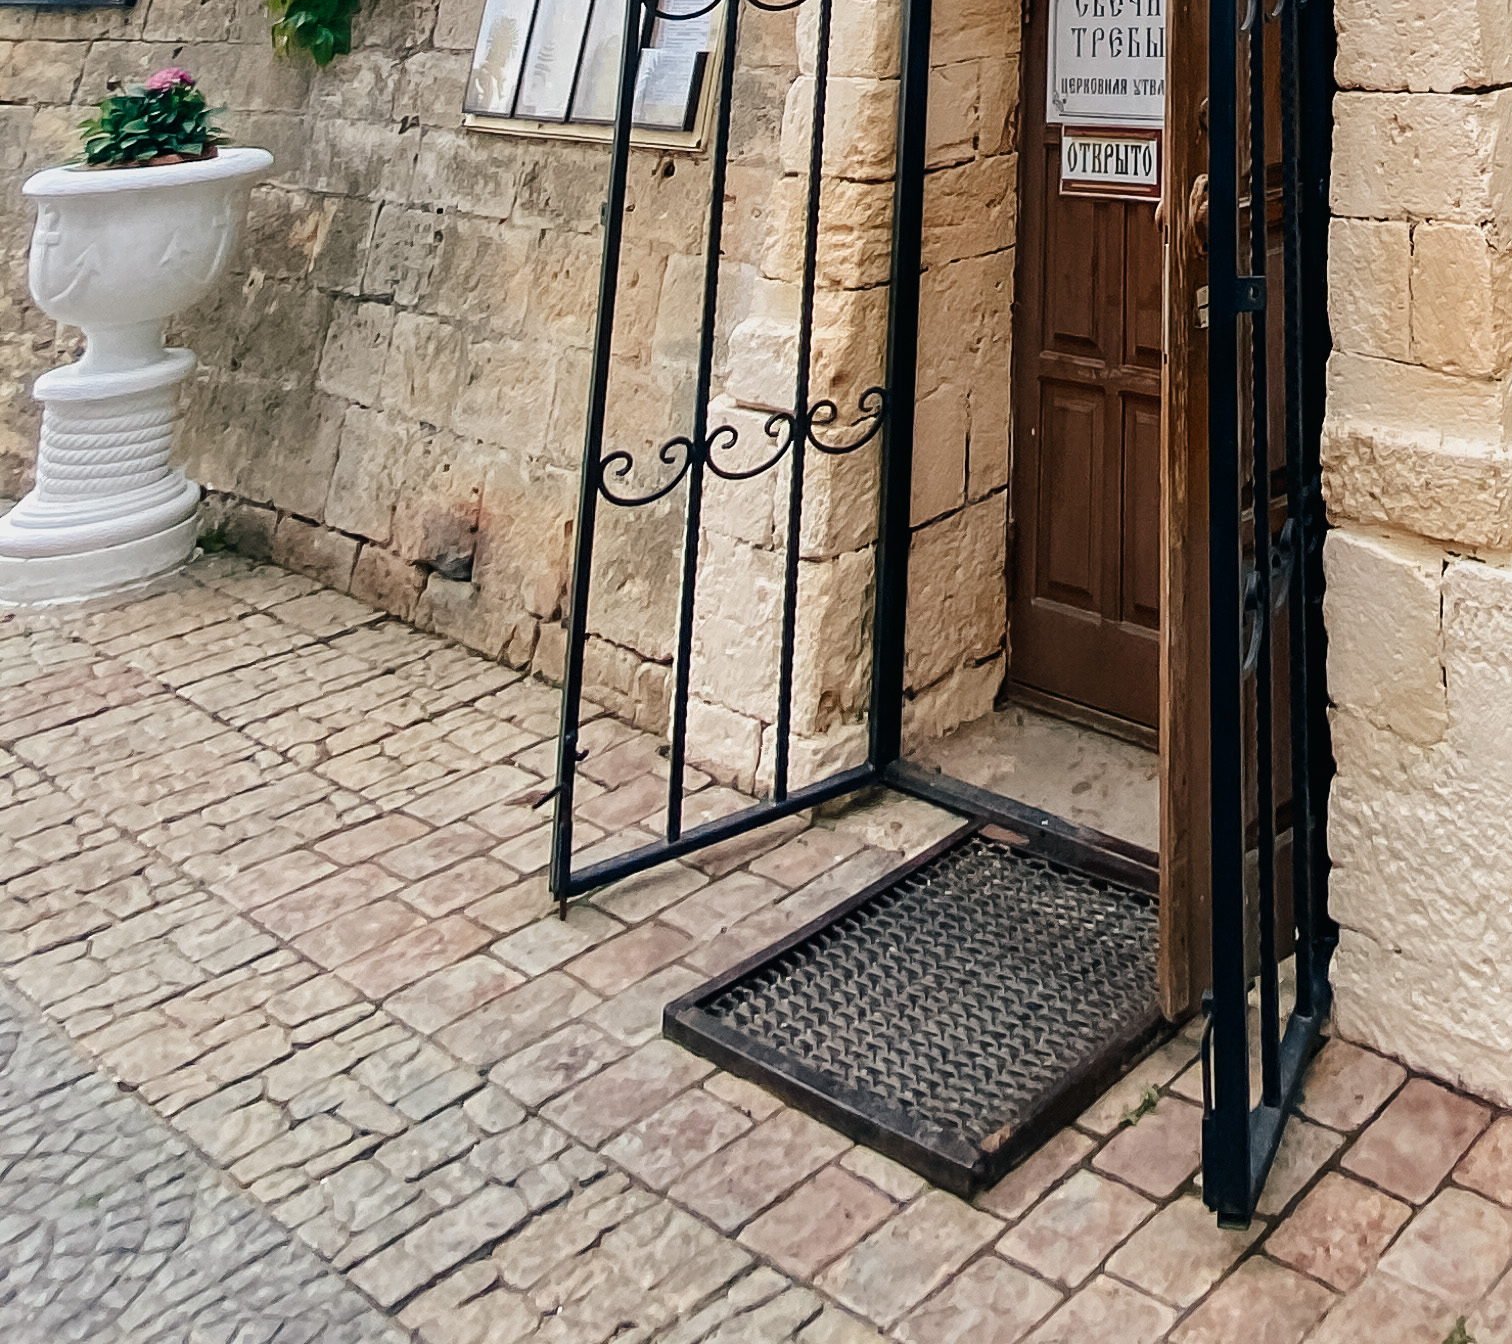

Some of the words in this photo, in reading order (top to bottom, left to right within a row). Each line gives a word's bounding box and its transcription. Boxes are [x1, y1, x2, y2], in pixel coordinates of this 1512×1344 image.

[1070, 26, 1165, 58] ТРЕБЫ
[1061, 76, 1128, 96] ЦЕРКОВНАЯ
[1132, 78, 1165, 96] УТВА
[1067, 142, 1153, 177] ОТКРЫТО
